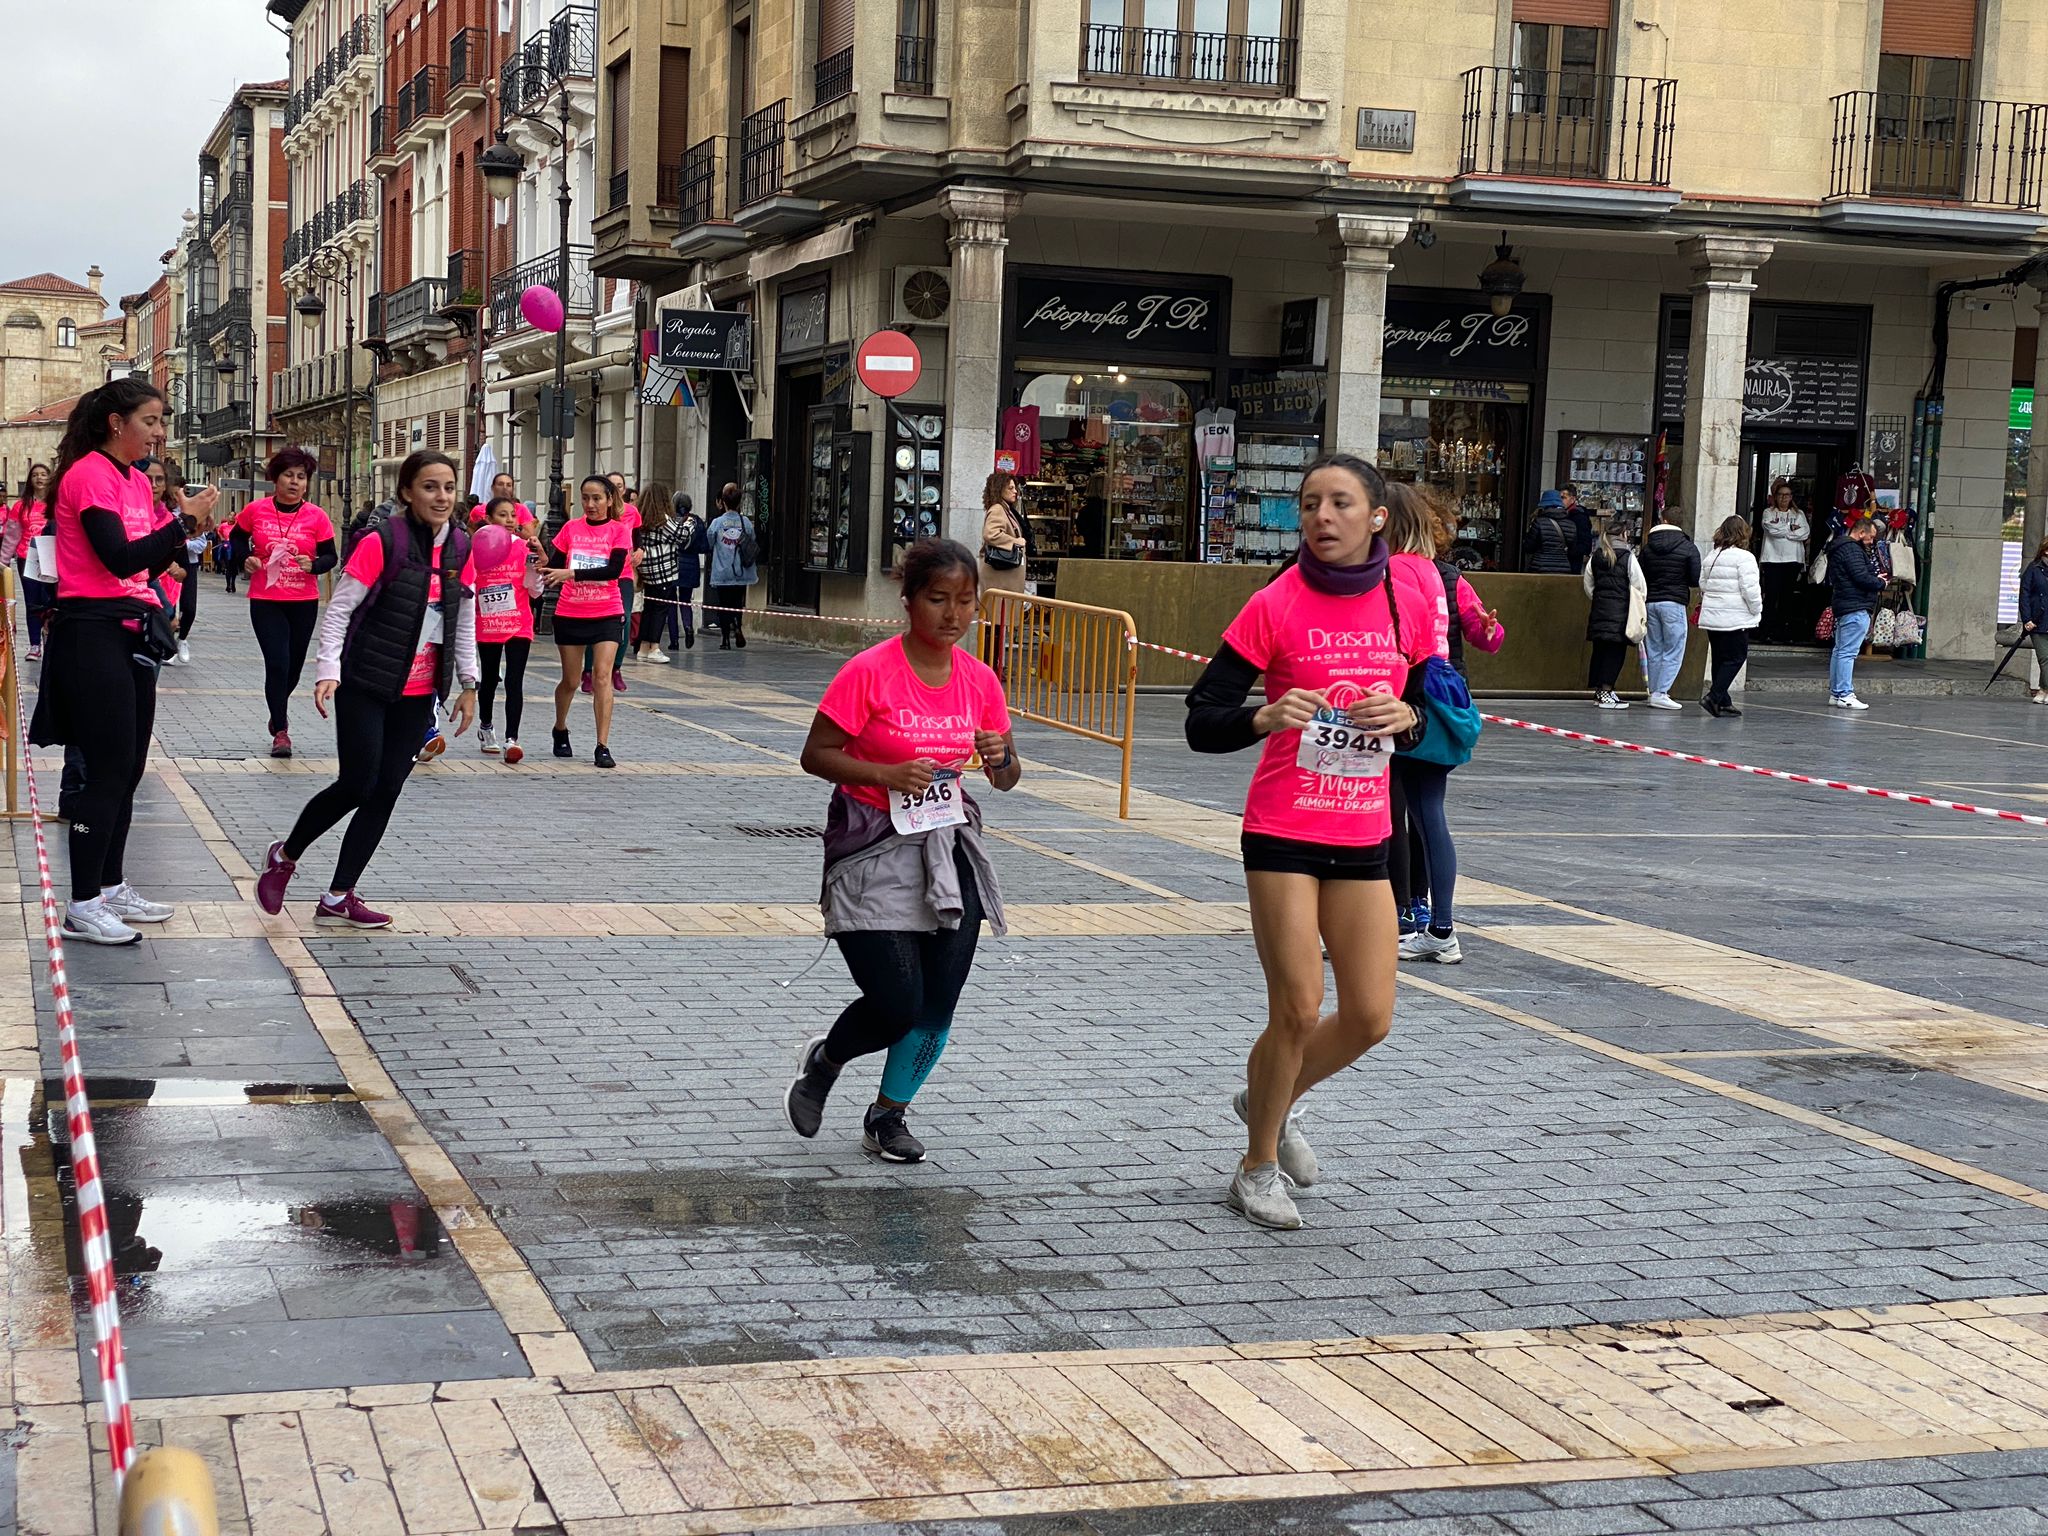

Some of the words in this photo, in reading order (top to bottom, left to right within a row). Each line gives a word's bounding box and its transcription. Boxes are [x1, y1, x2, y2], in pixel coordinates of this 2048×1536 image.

[1370, 122, 1401, 133] PLAZA
[1362, 135, 1375, 143] DE
[1376, 136, 1408, 145] REGLA
[665, 318, 717, 340] Regalos
[665, 342, 721, 360] Souvenir
[1743, 378, 1781, 397] NAURA
[1242, 400, 1264, 416] DE
[1202, 425, 1230, 437] LEON
[482, 592, 508, 603] 3337
[1308, 624, 1396, 650] Drasanvi
[899, 703, 974, 730] Drasanvi
[1314, 725, 1383, 754] 3944
[901, 782, 952, 810] 3946
[1318, 774, 1377, 801] Mujer
[1294, 796, 1336, 809] ALMOM
